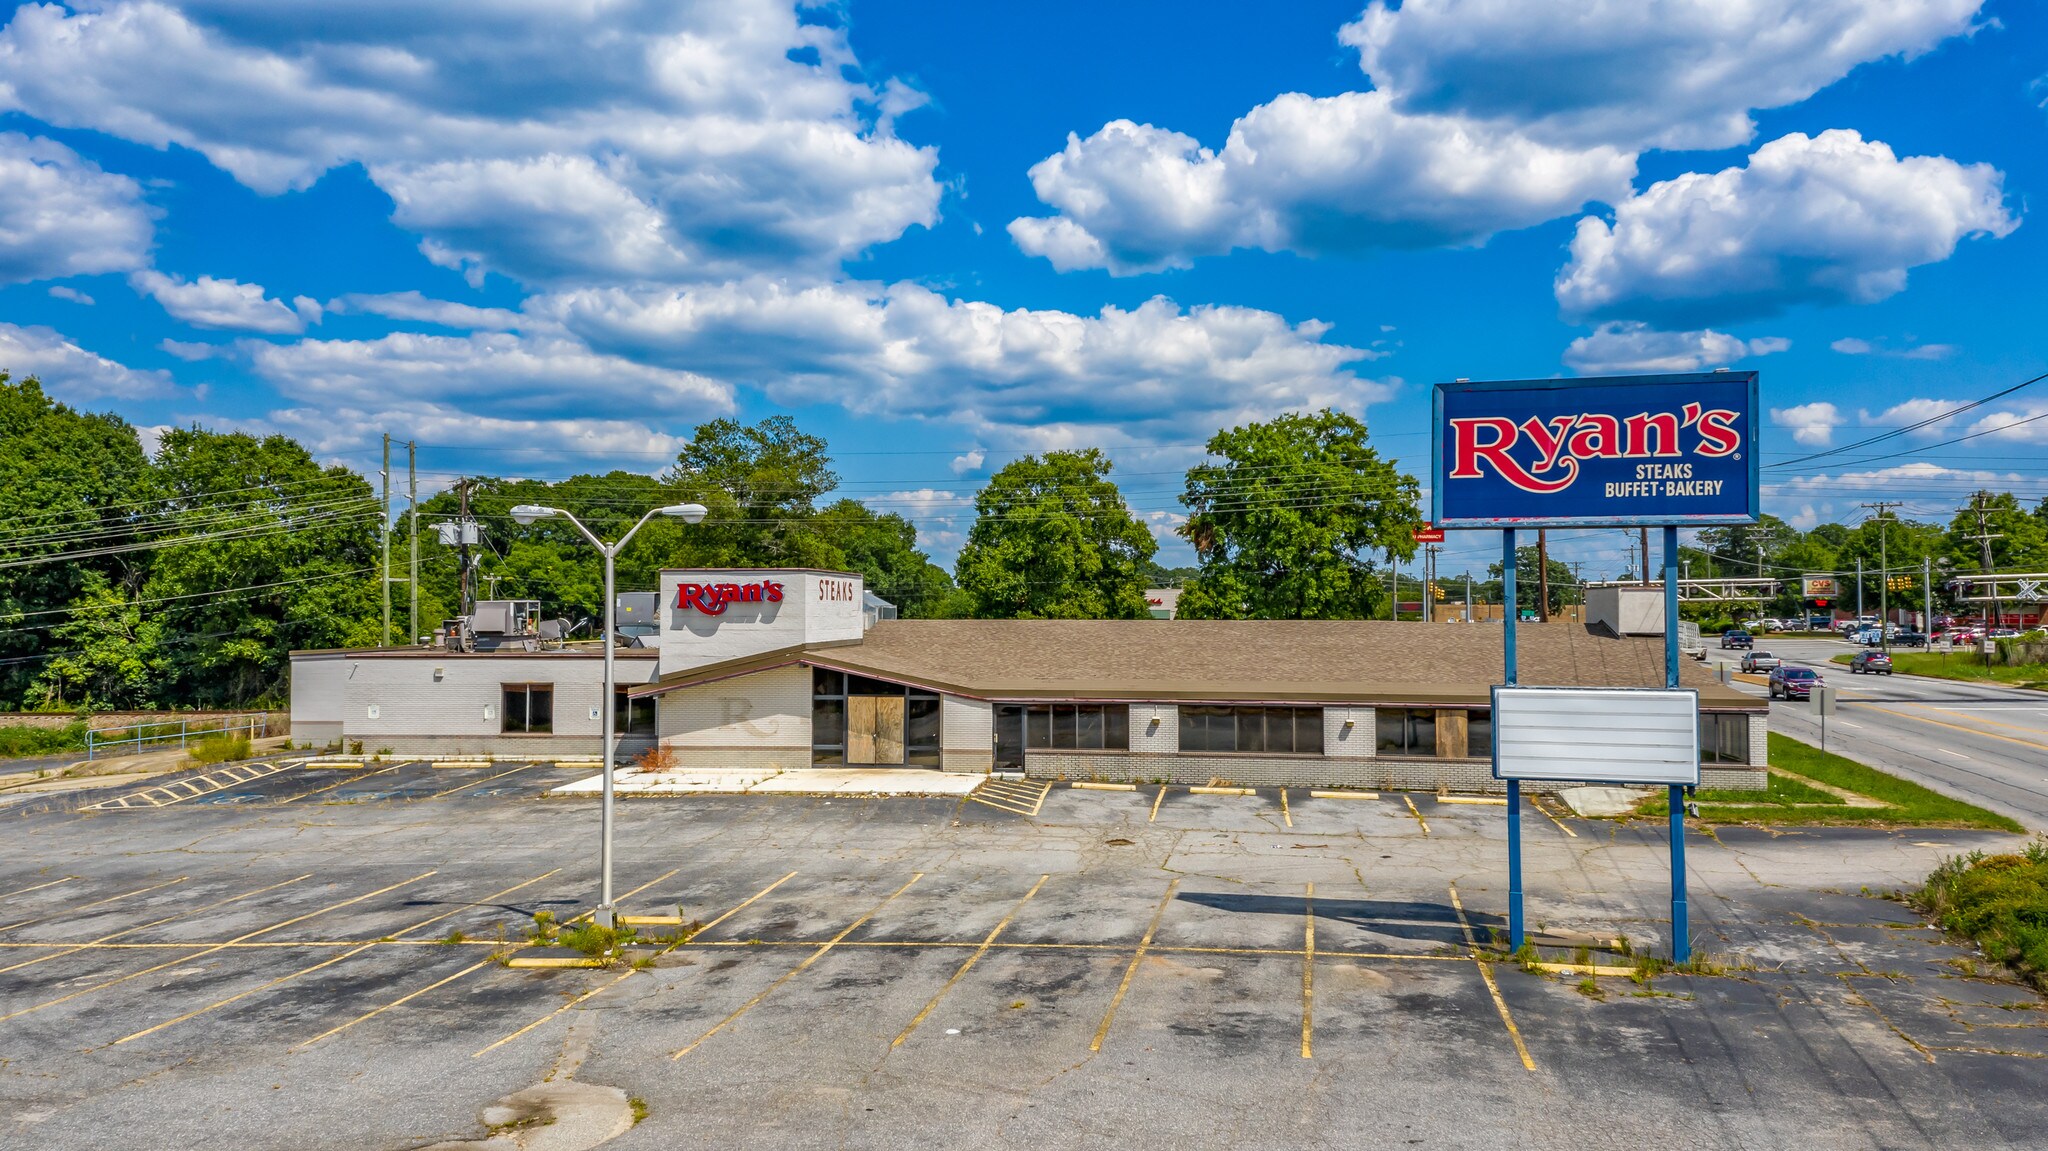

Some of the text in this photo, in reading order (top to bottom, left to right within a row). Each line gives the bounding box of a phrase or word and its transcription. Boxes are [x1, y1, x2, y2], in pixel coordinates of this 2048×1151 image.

[1450, 402, 1741, 493] Ryan's
[1636, 463, 1693, 480] STEAKS
[677, 580, 785, 616] Ryan's
[819, 579, 853, 602] STEAKS
